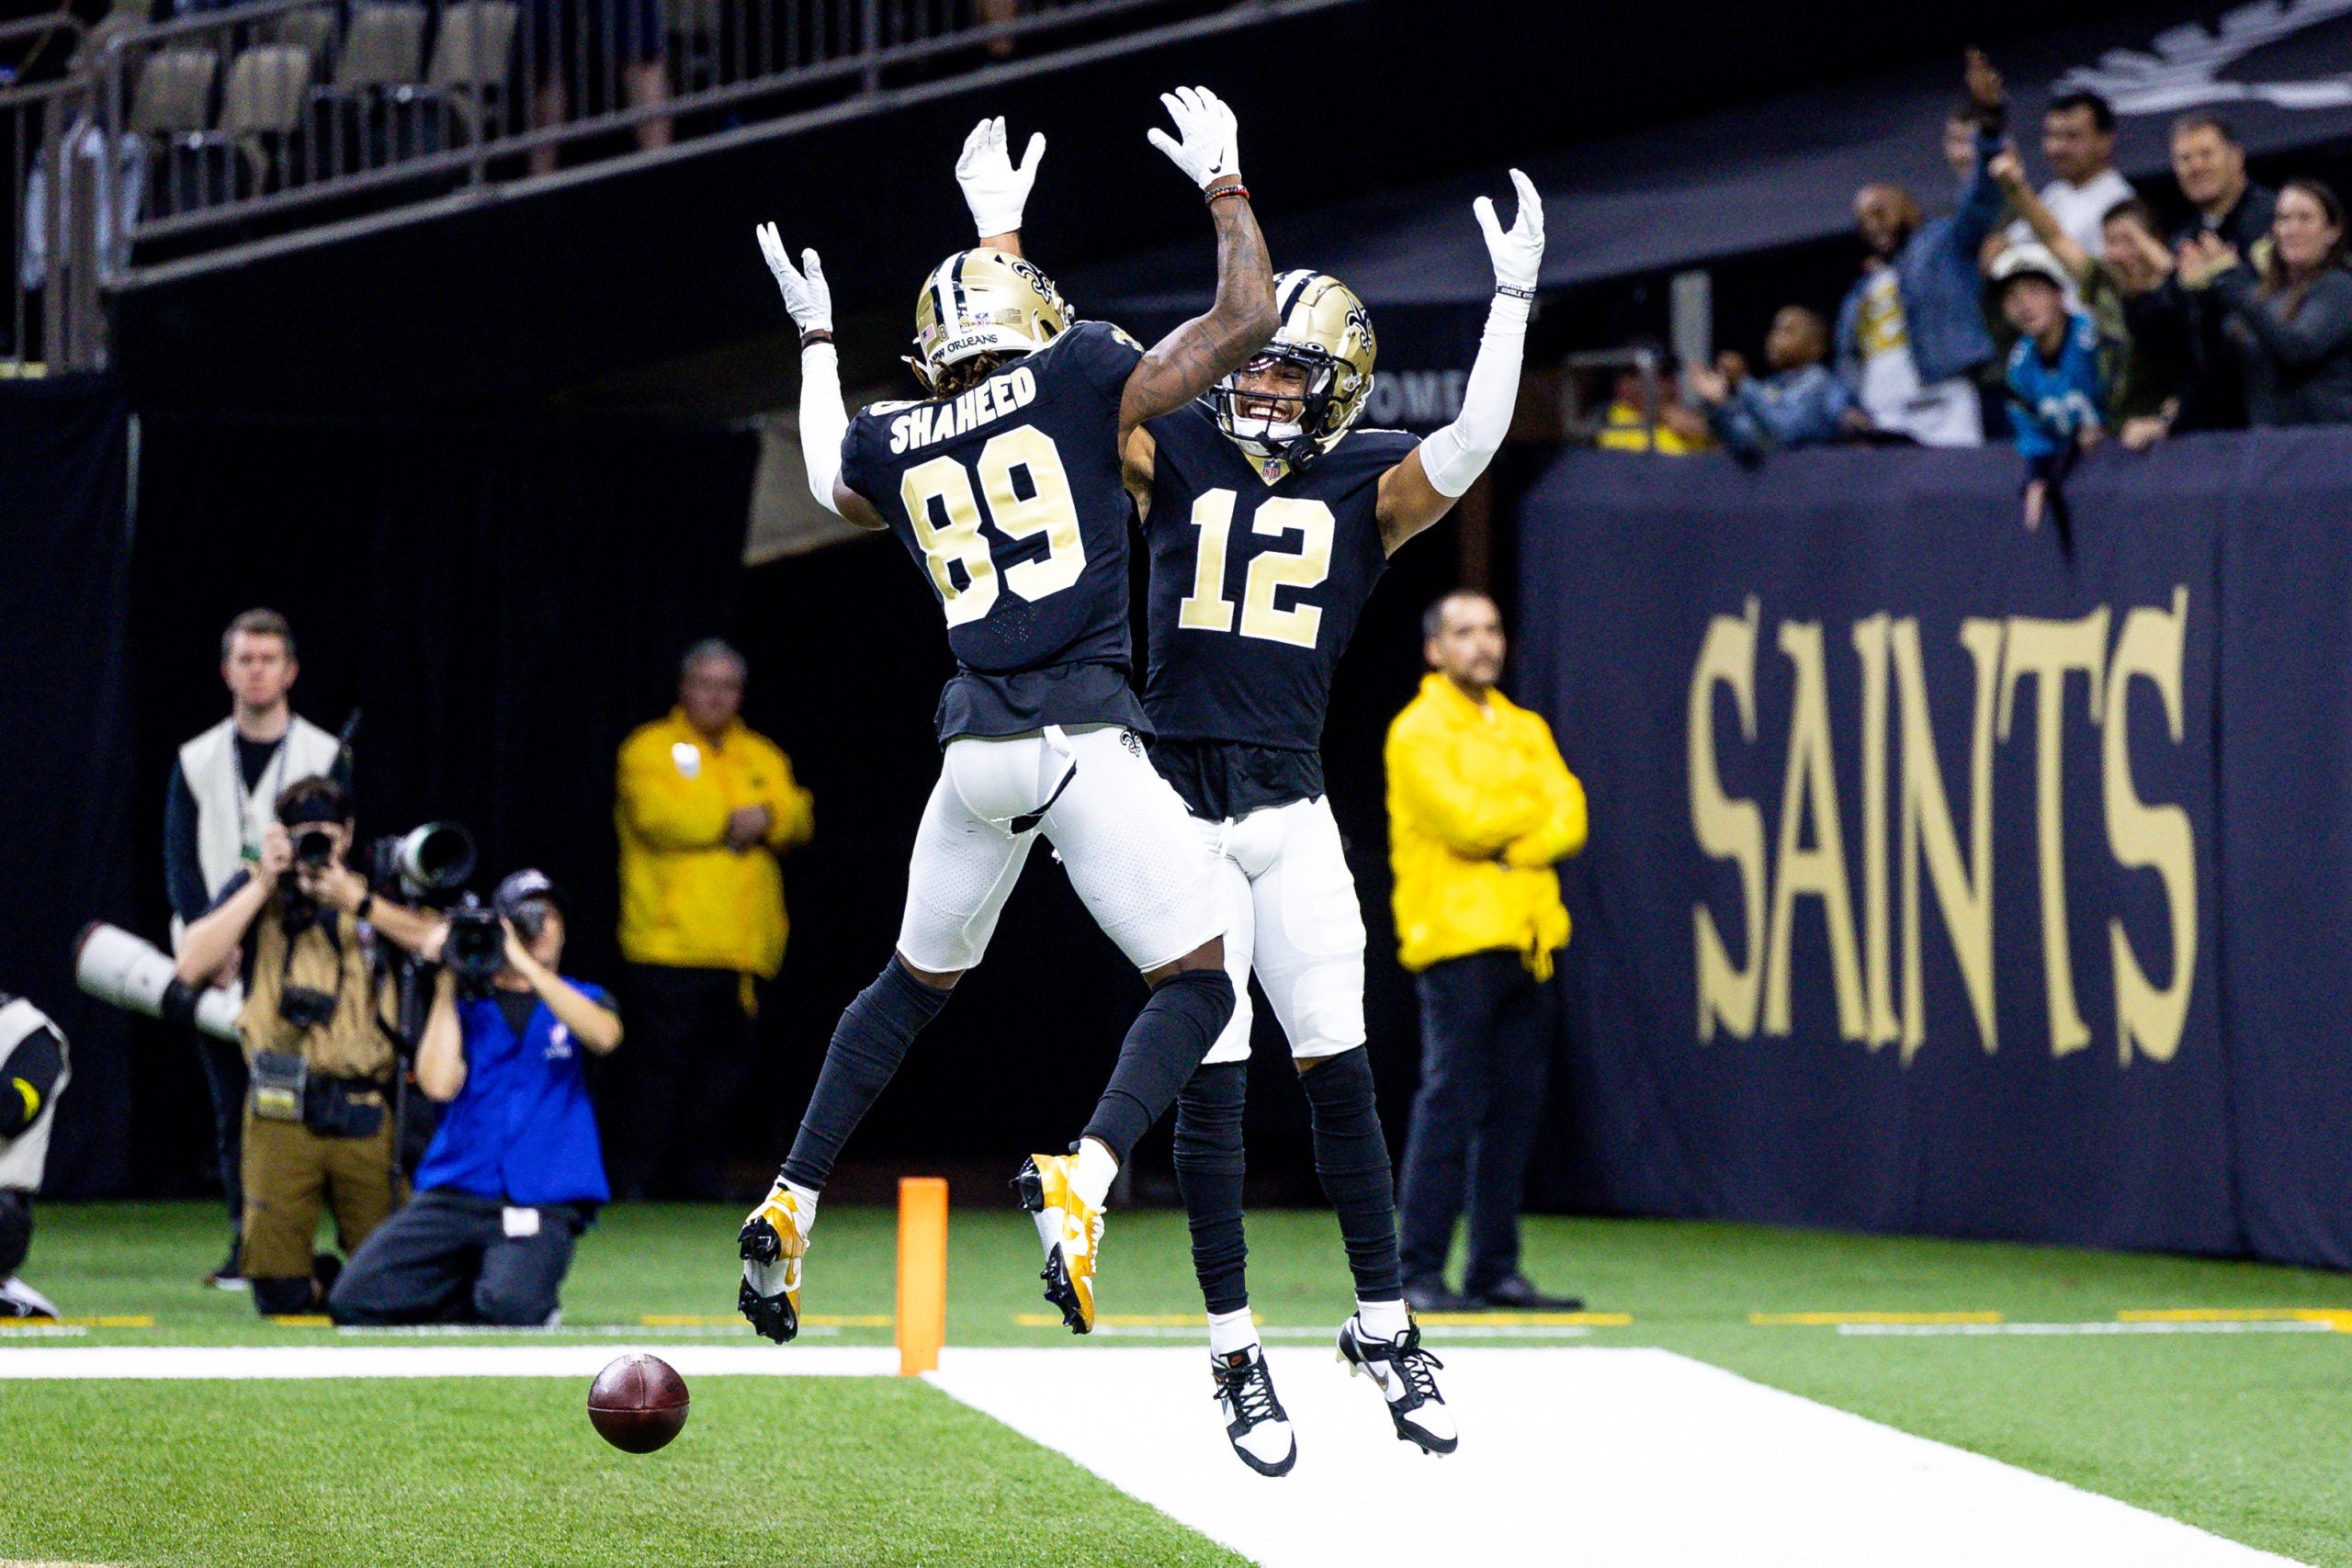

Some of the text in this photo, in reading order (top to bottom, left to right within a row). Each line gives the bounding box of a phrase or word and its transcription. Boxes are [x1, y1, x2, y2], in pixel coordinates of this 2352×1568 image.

[889, 367, 1036, 455] SHAHEED
[947, 333, 999, 353] ORLEANS
[899, 424, 1087, 630] 89
[1179, 487, 1336, 649] 12
[1688, 584, 2198, 1067] SAINTS
